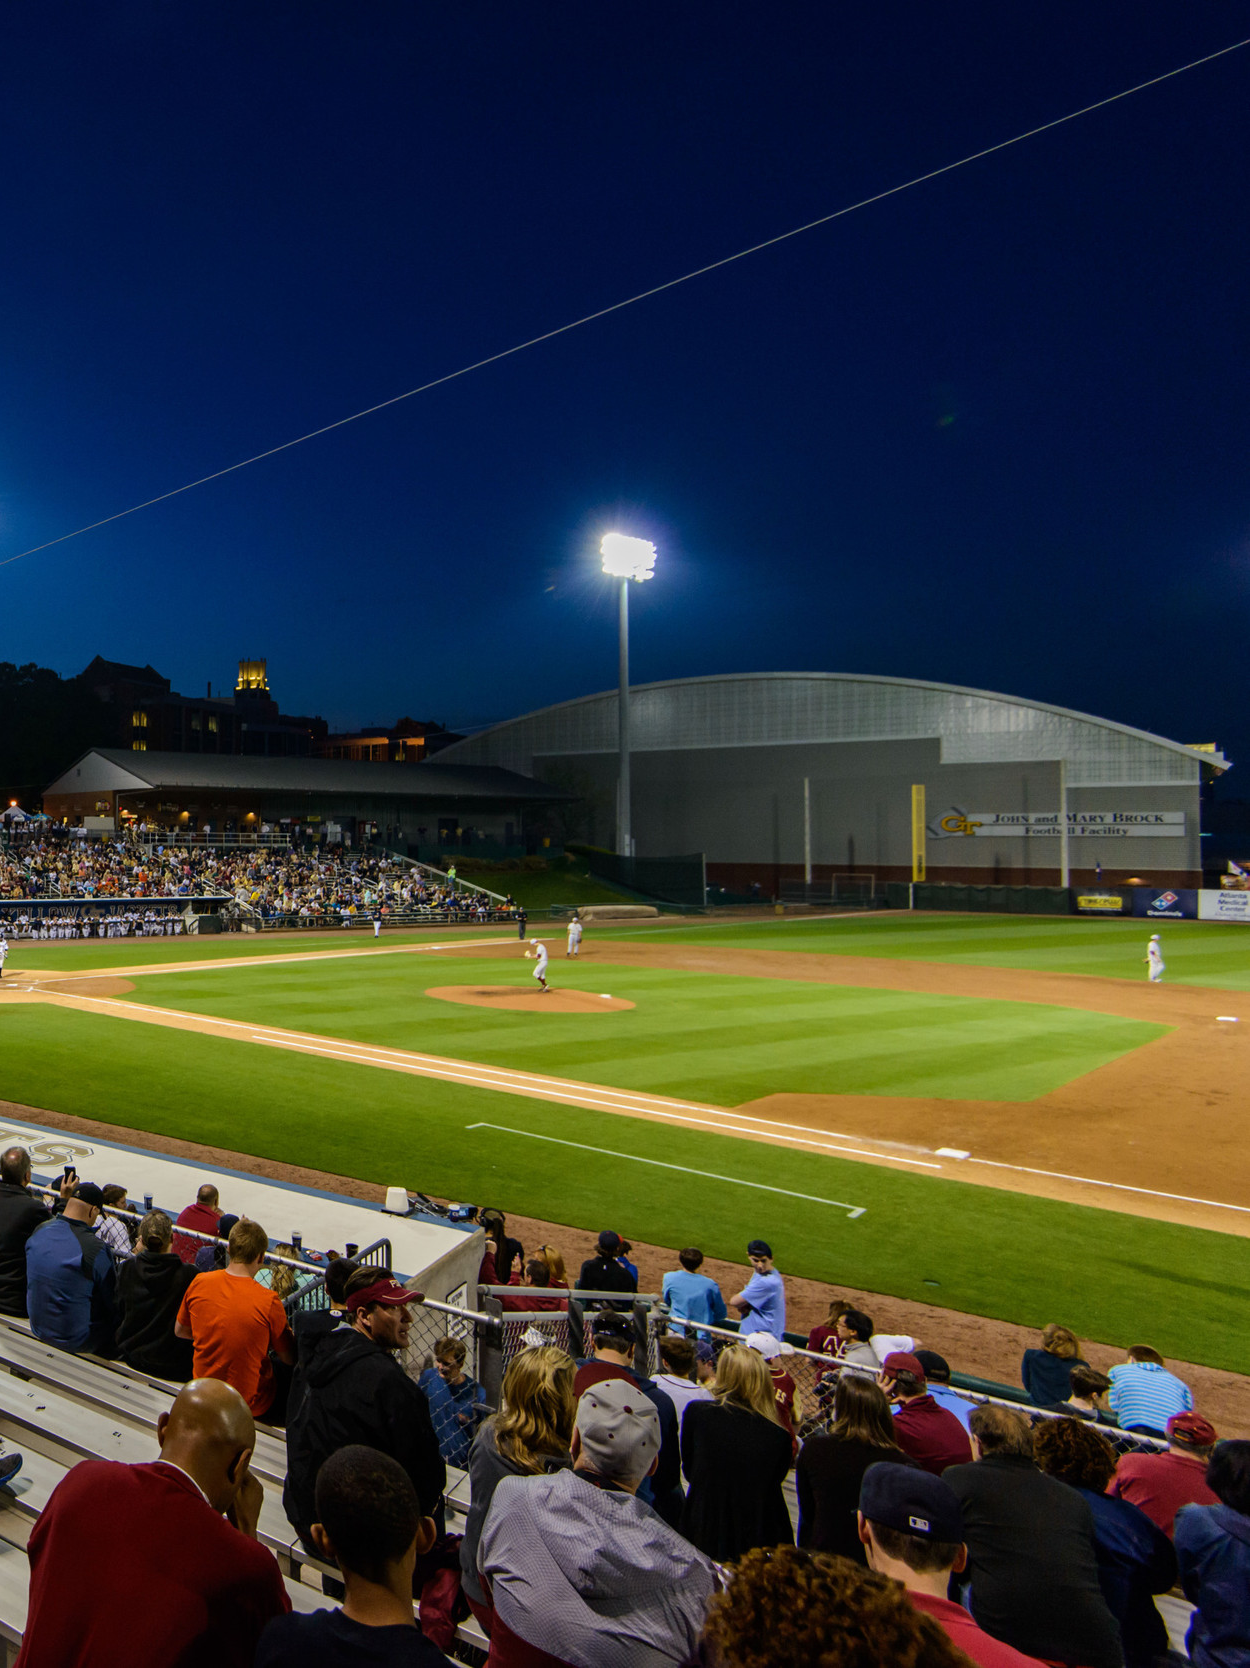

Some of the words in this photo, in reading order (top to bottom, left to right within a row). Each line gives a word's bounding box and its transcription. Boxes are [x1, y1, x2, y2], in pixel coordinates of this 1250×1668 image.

[993, 814, 1029, 824] JOHN
[1067, 813, 1104, 823] MARY
[1113, 813, 1164, 823] BROCK
[1025, 827, 1075, 836] Footbll
[1081, 826, 1130, 836] Facility
